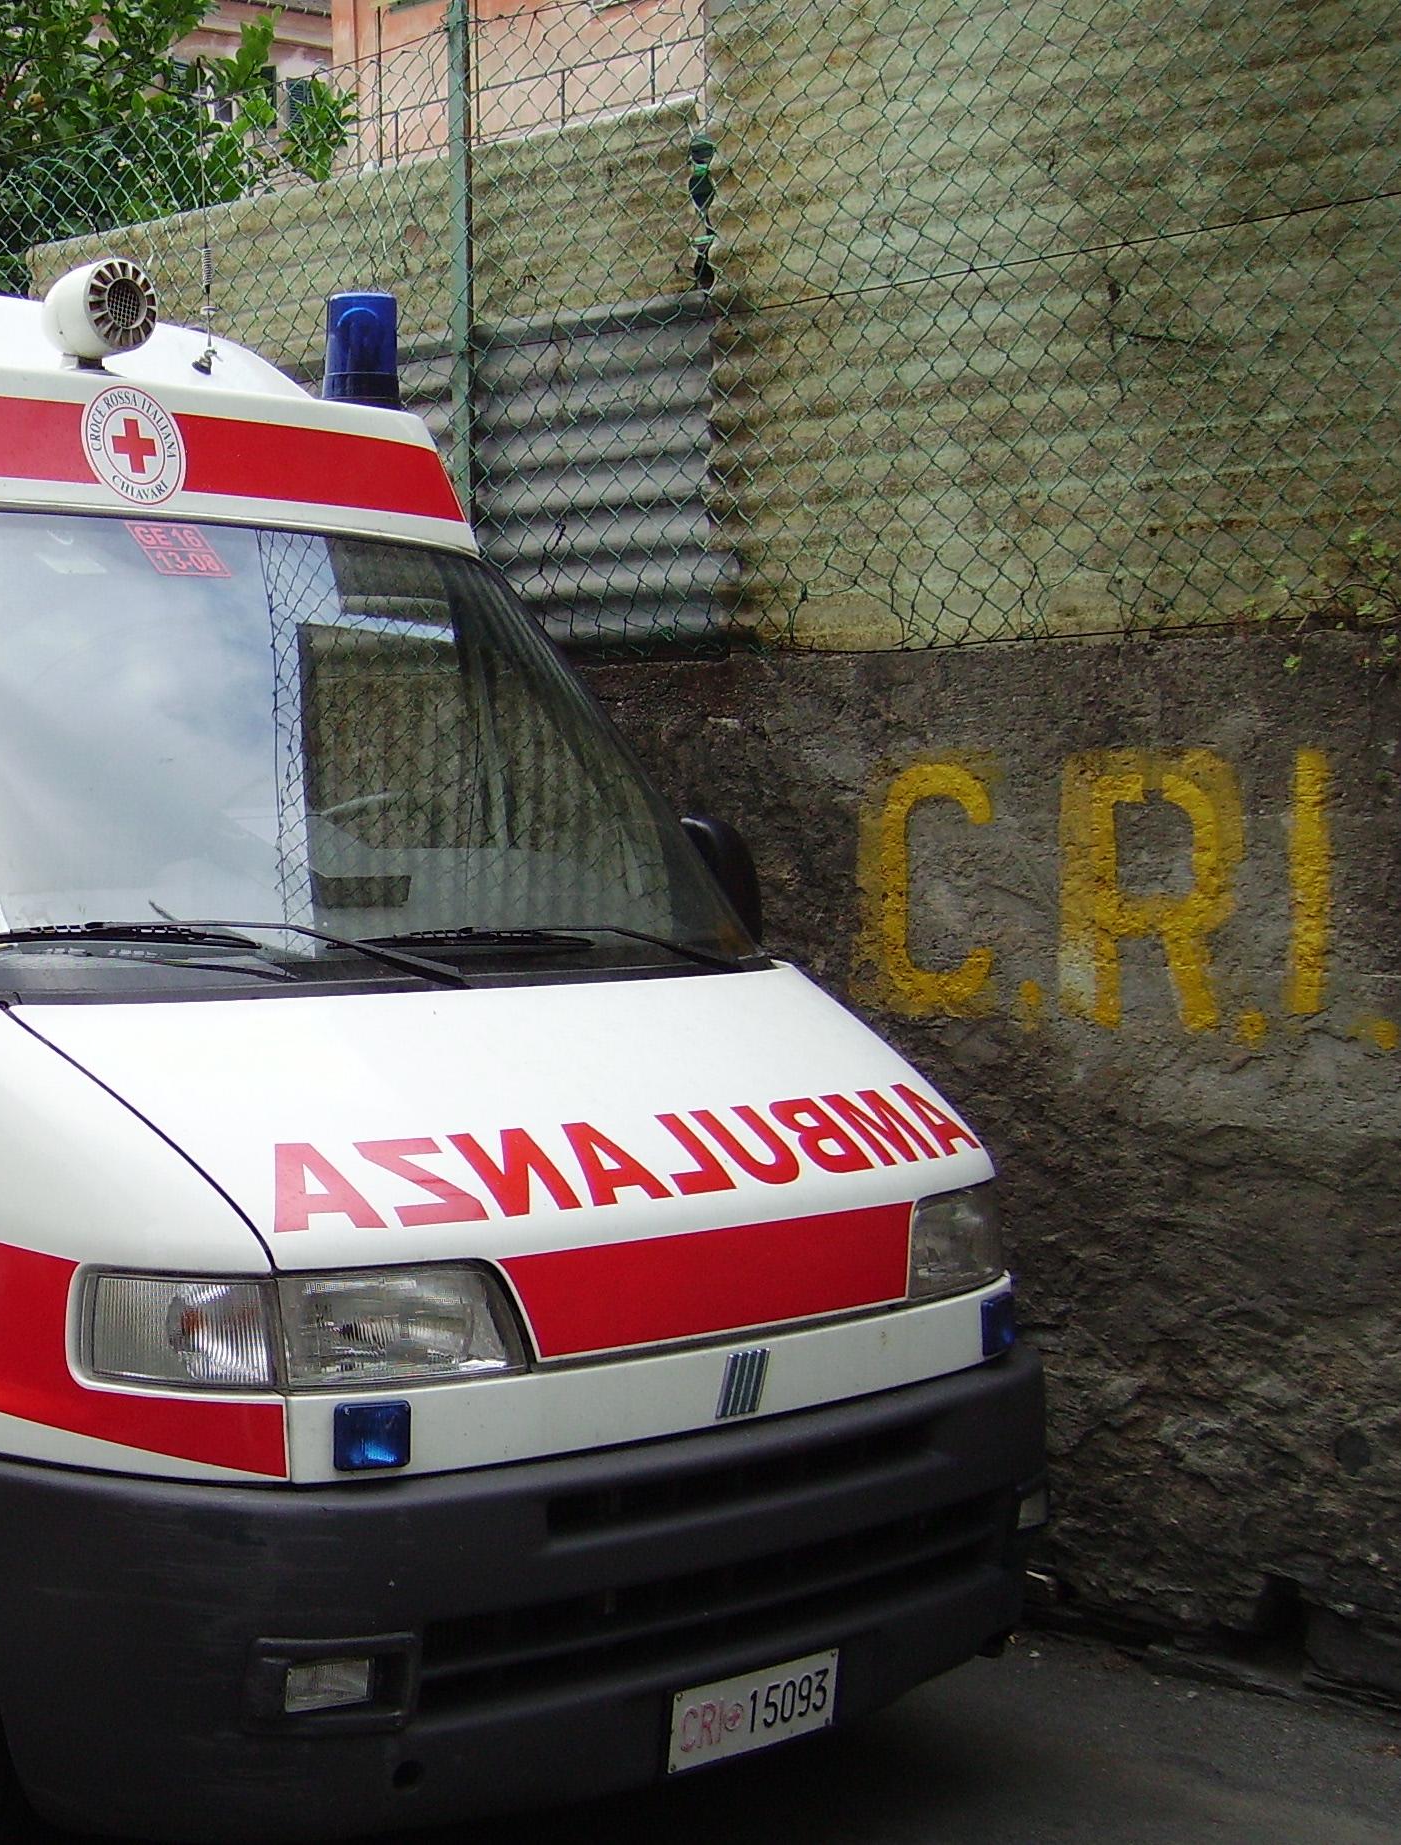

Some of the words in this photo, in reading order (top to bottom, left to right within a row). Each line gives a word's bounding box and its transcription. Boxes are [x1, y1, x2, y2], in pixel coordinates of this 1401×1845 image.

[89, 404, 107, 452] CROCE
[103, 391, 138, 411] ROSSA
[140, 396, 177, 459] ITALIANA
[111, 473, 169, 500] CHIAVARI
[133, 526, 171, 547] GE
[171, 528, 202, 548] 16
[155, 551, 221, 572] 13-08
[680, 1700, 724, 1753] CRI
[749, 1667, 829, 1734] 15093
